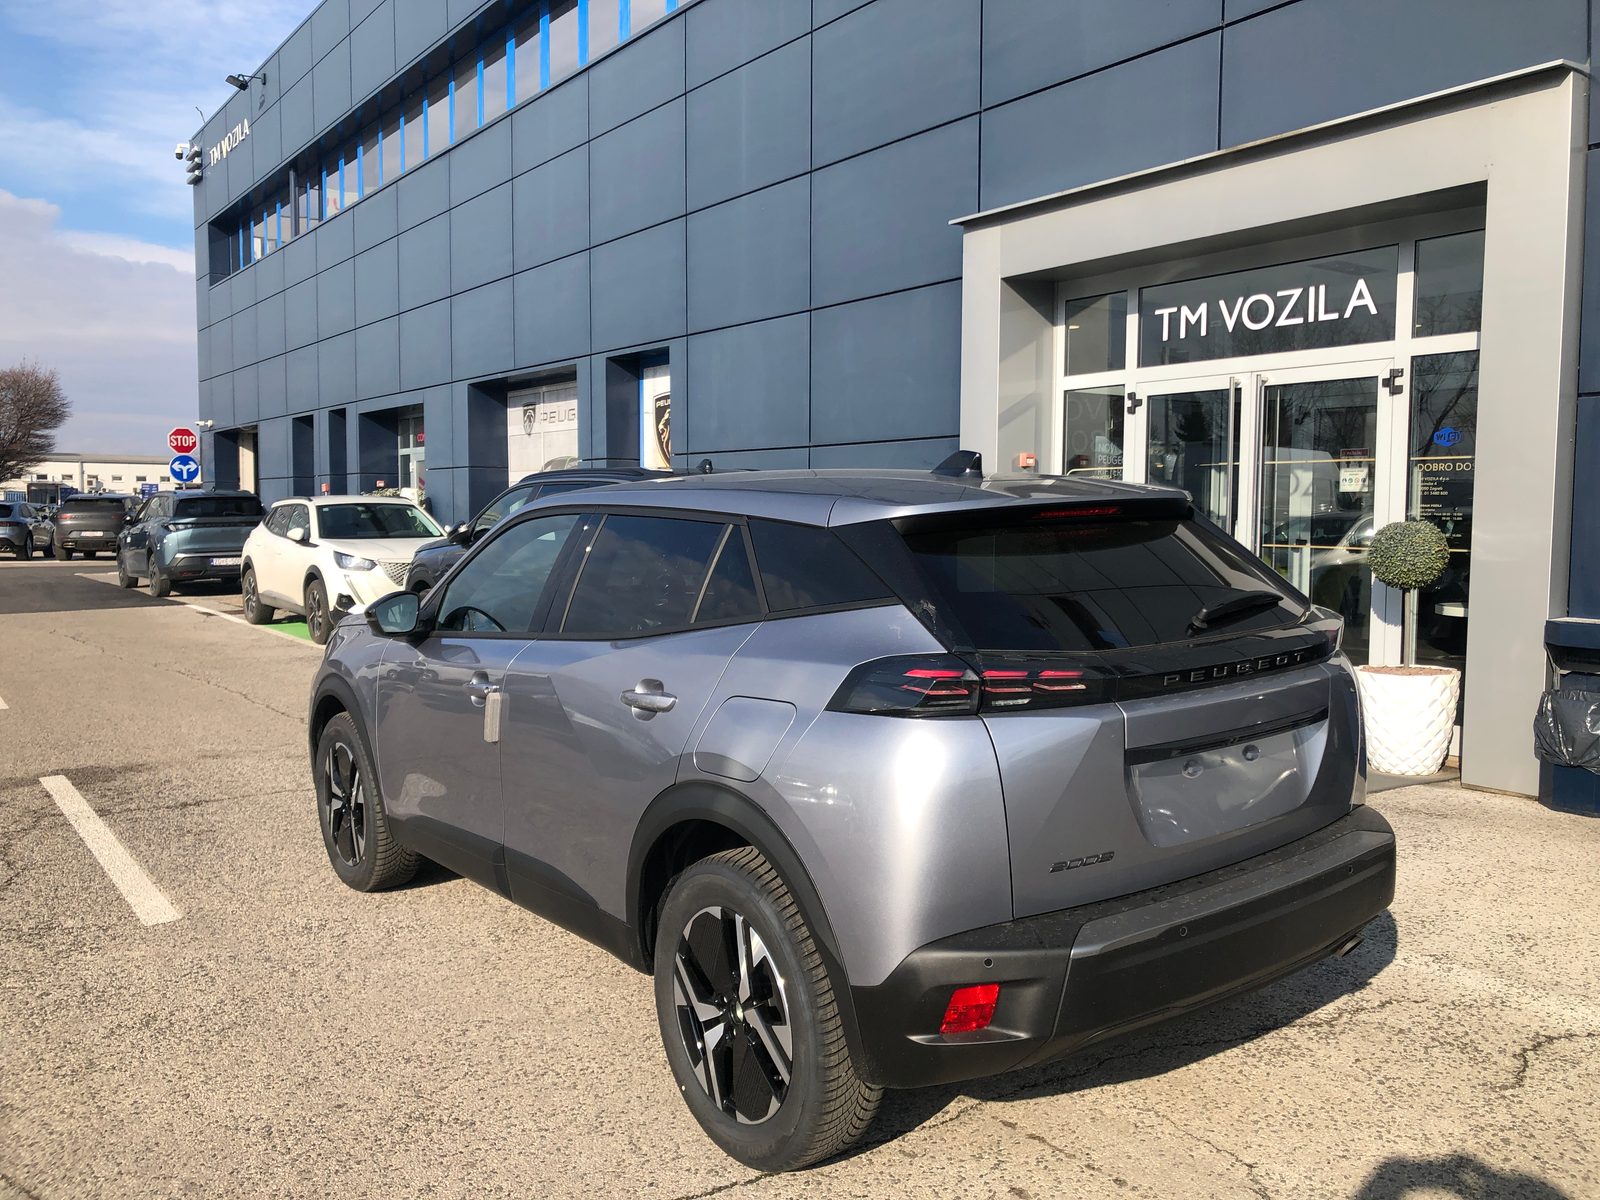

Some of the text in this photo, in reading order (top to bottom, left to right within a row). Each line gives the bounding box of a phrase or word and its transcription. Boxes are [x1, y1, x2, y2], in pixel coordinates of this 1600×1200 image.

[209, 118, 250, 167] TM VOZILA
[1154, 278, 1378, 342] TM VOZILA
[540, 407, 576, 425] PEUG
[170, 435, 196, 447] STOP
[1097, 454, 1123, 465] PEUGE
[1417, 462, 1453, 472] DOBRO
[1163, 651, 1305, 686] PEUGEOT
[1049, 850, 1115, 874] 2008
